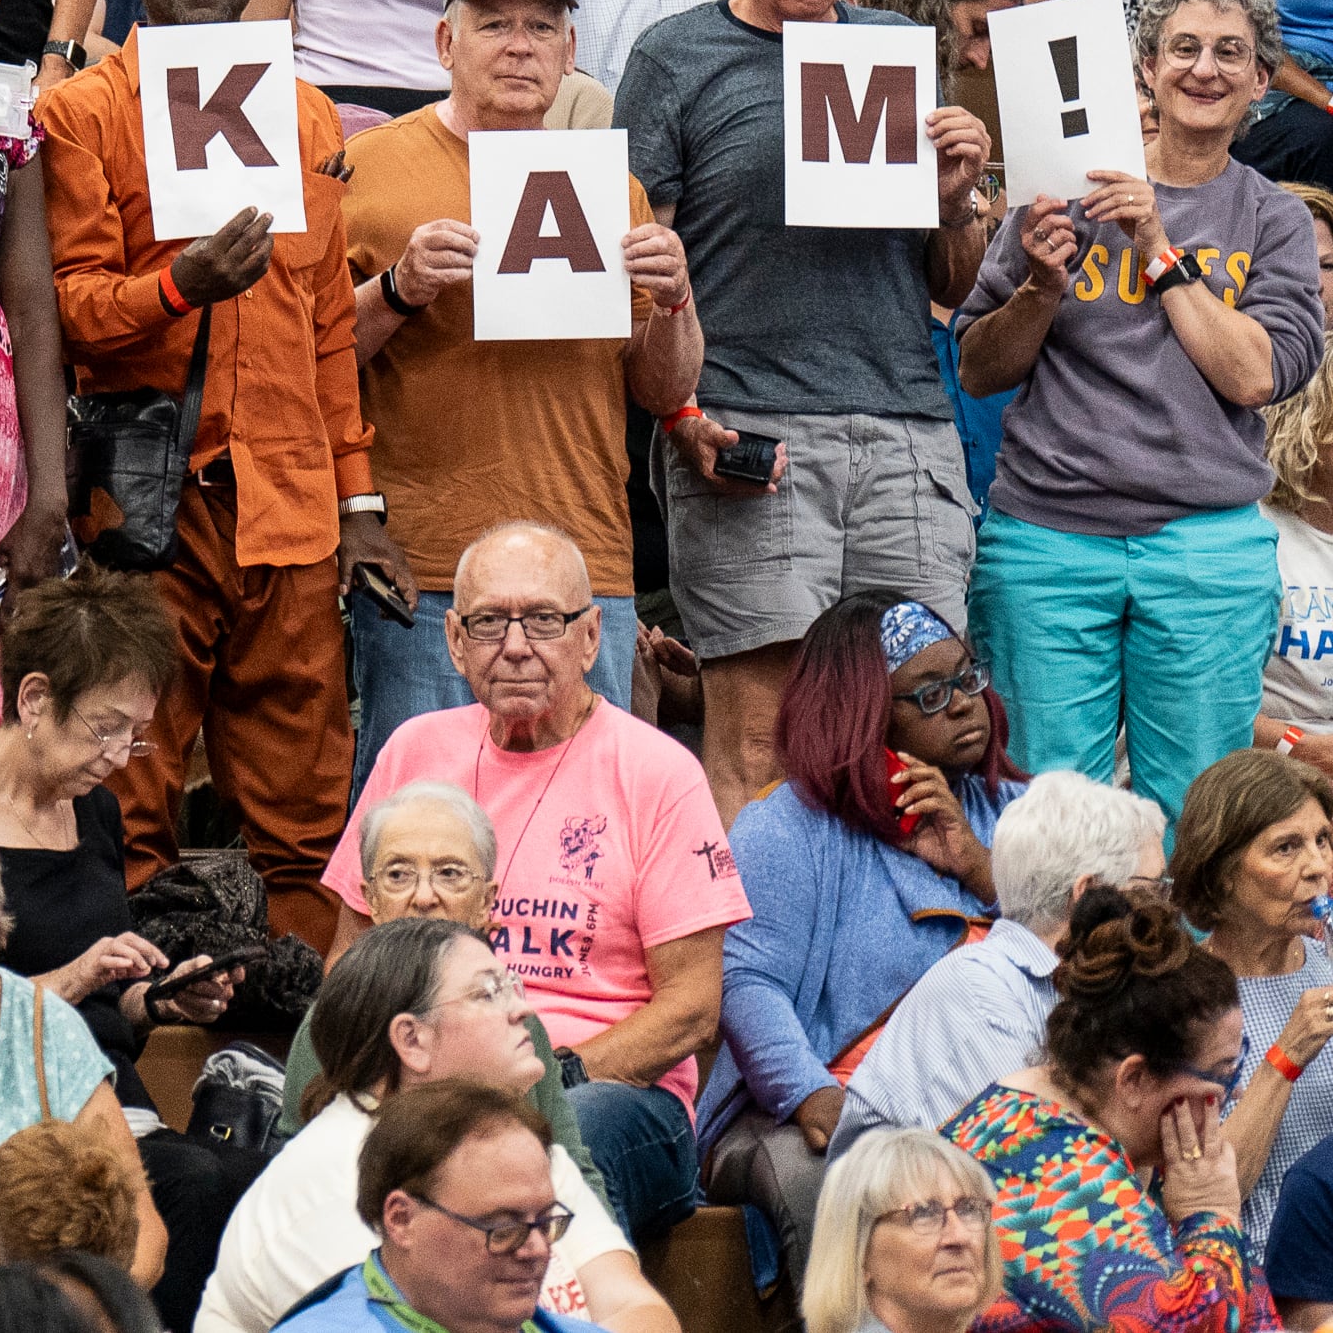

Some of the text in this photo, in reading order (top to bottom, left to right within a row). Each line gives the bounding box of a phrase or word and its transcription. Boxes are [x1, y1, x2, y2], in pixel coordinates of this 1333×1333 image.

[165, 62, 279, 172] K
[799, 62, 918, 165] M
[496, 170, 606, 275] A
[493, 926, 577, 958] ALK
[506, 962, 576, 979] HUNGRY
